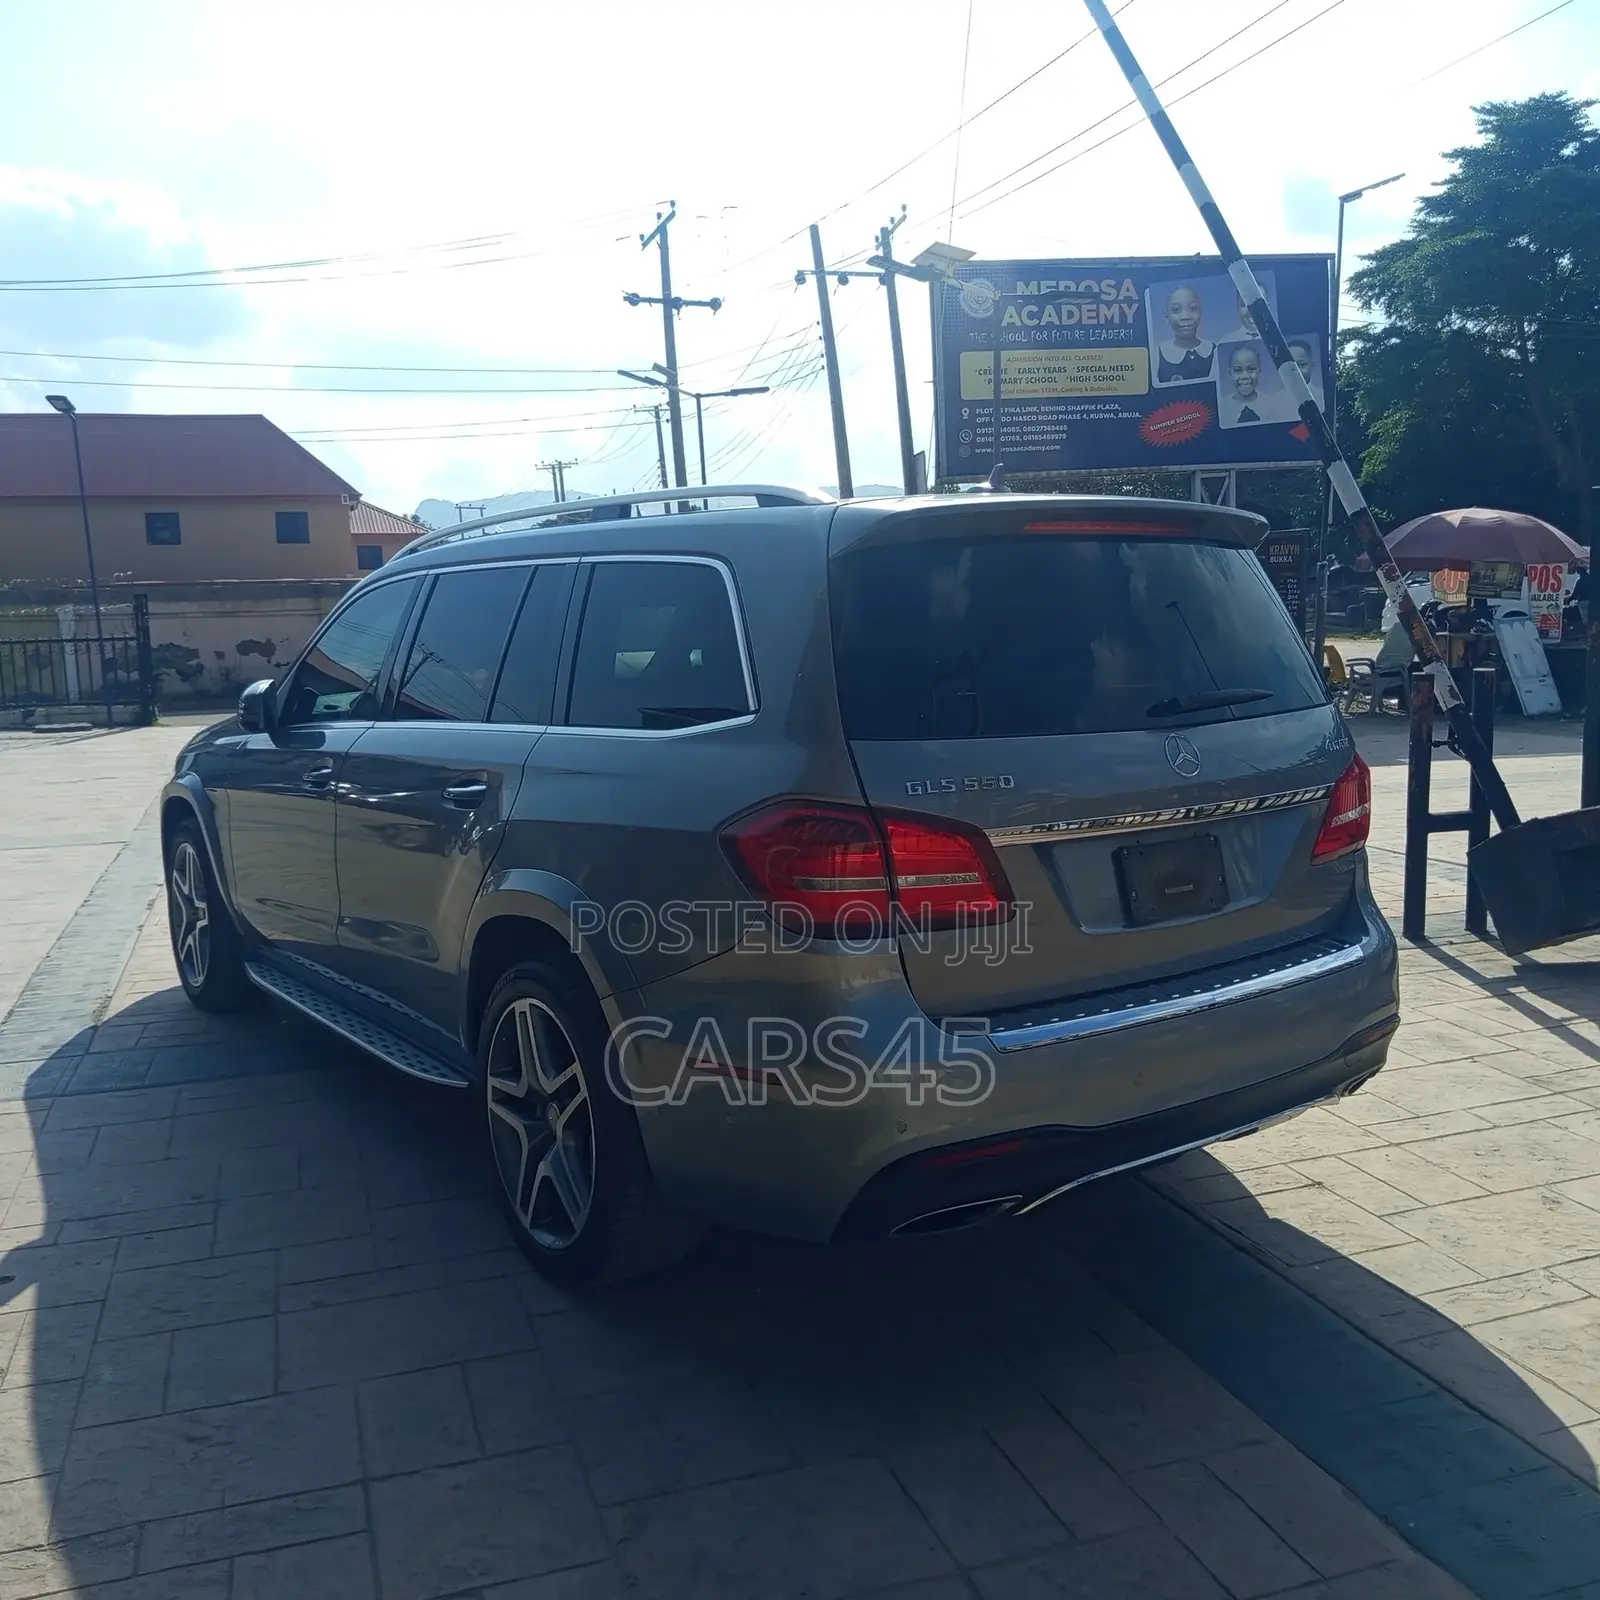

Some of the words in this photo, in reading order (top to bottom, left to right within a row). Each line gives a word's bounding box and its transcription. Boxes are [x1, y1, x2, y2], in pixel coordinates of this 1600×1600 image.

[1001, 303, 1139, 326] ACADEMY
[969, 332, 988, 343] THE
[1031, 330, 1048, 342] FOR
[1051, 329, 1085, 341] FUTURE
[1089, 328, 1133, 341] LEADERS!
[1006, 355, 1043, 363] ADMISSION
[1017, 367, 1041, 375] EARLY
[1043, 366, 1067, 374] YEARS
[1076, 365, 1107, 373] SPECIAL
[1109, 364, 1135, 372] NEEDS
[987, 377, 1023, 385] PMARY
[1024, 376, 1058, 384] SCHOOL
[1069, 375, 1091, 383] HIGH
[1093, 374, 1126, 382] SCHOOL
[1097, 403, 1121, 411] PLAZA,
[1150, 419, 1175, 431] SUMMER
[1175, 412, 1201, 423] SCHOOL
[1269, 544, 1300, 555] KRAVYN
[1269, 555, 1293, 563] BUKKA
[1528, 565, 1563, 593] POS
[905, 778, 956, 796] GLS
[963, 775, 1014, 791] 550
